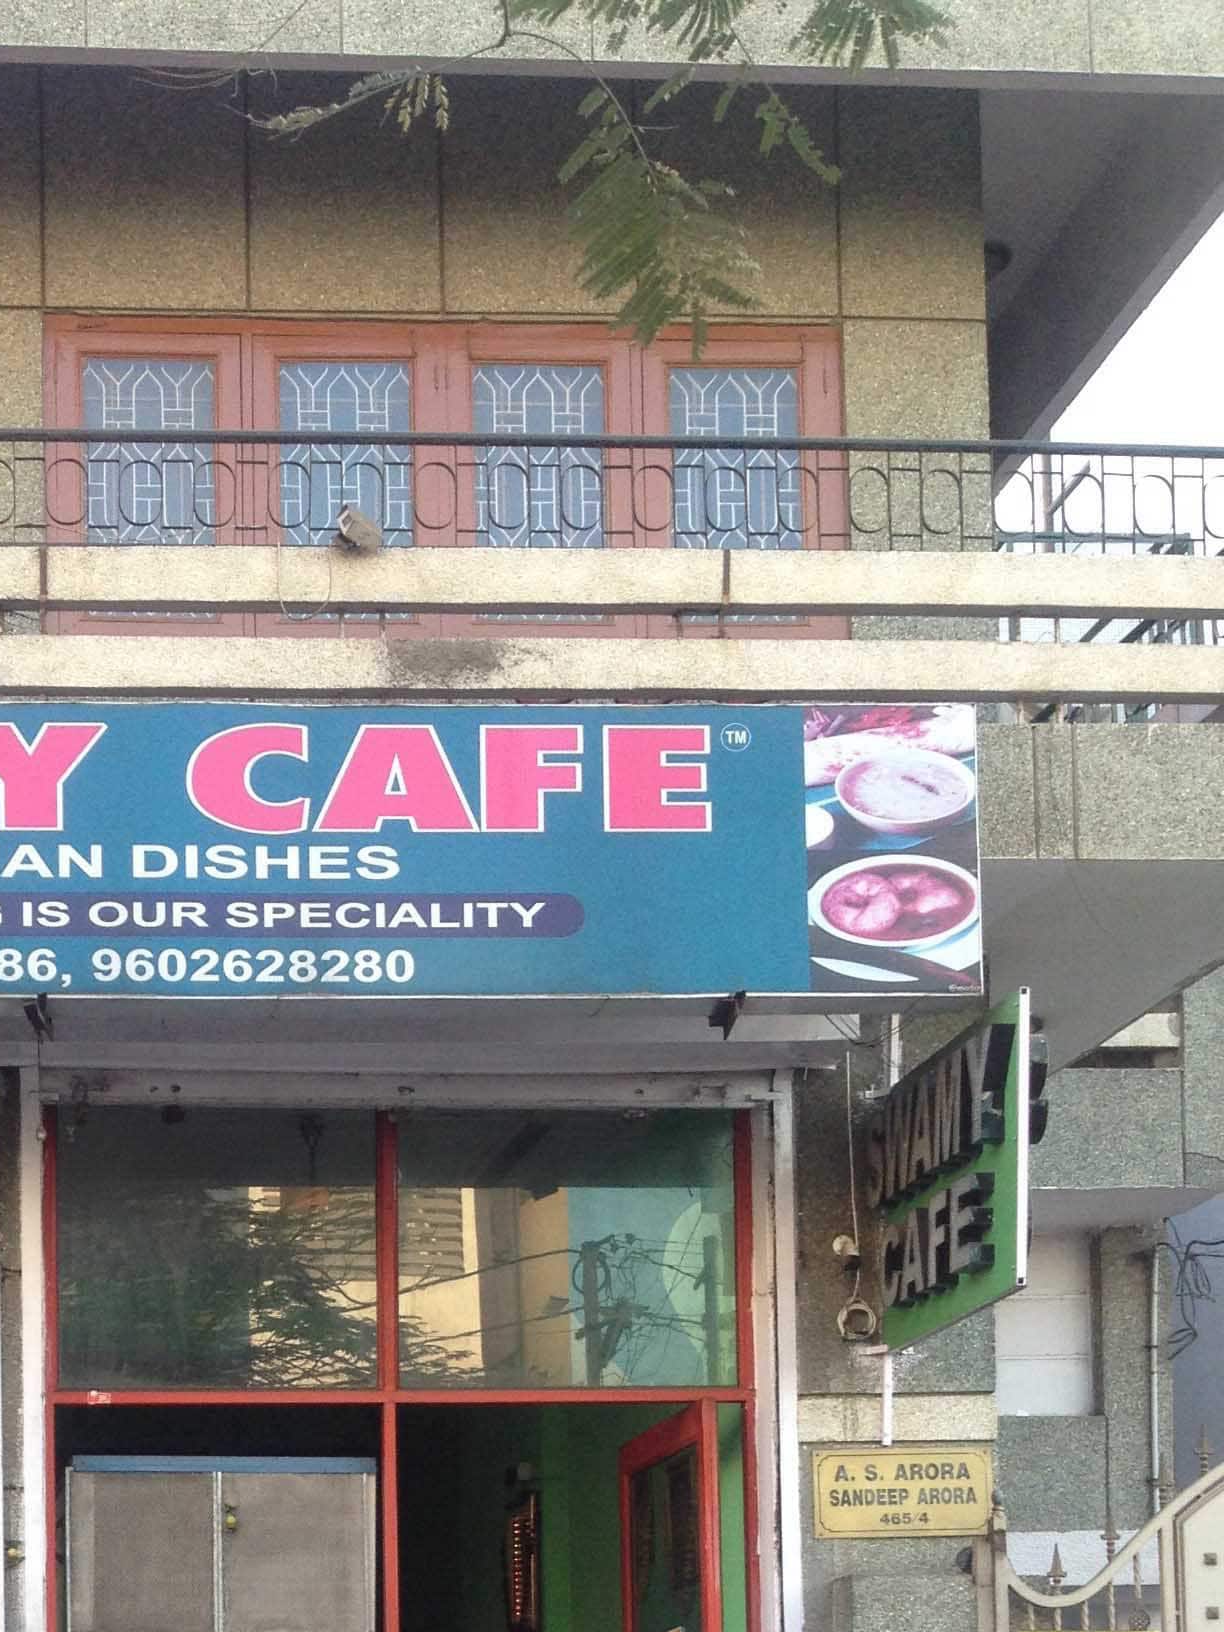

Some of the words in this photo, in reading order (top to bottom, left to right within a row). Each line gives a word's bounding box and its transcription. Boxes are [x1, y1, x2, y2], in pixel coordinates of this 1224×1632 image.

[186, 723, 712, 836] CAFE
[132, 844, 401, 880] DISHES
[22, 901, 71, 928] IS
[88, 901, 209, 928] OUR
[225, 901, 546, 929] SPECIALITY
[91, 949, 415, 983] 9602628280
[881, 1172, 992, 1308] CAFE
[834, 1464, 856, 1482] A.
[864, 1463, 884, 1481] S.
[894, 1462, 971, 1481] ARORA
[829, 1488, 909, 1507] SANDEEP
[917, 1486, 978, 1505] ARORA
[879, 1512, 930, 1526] 465/4
